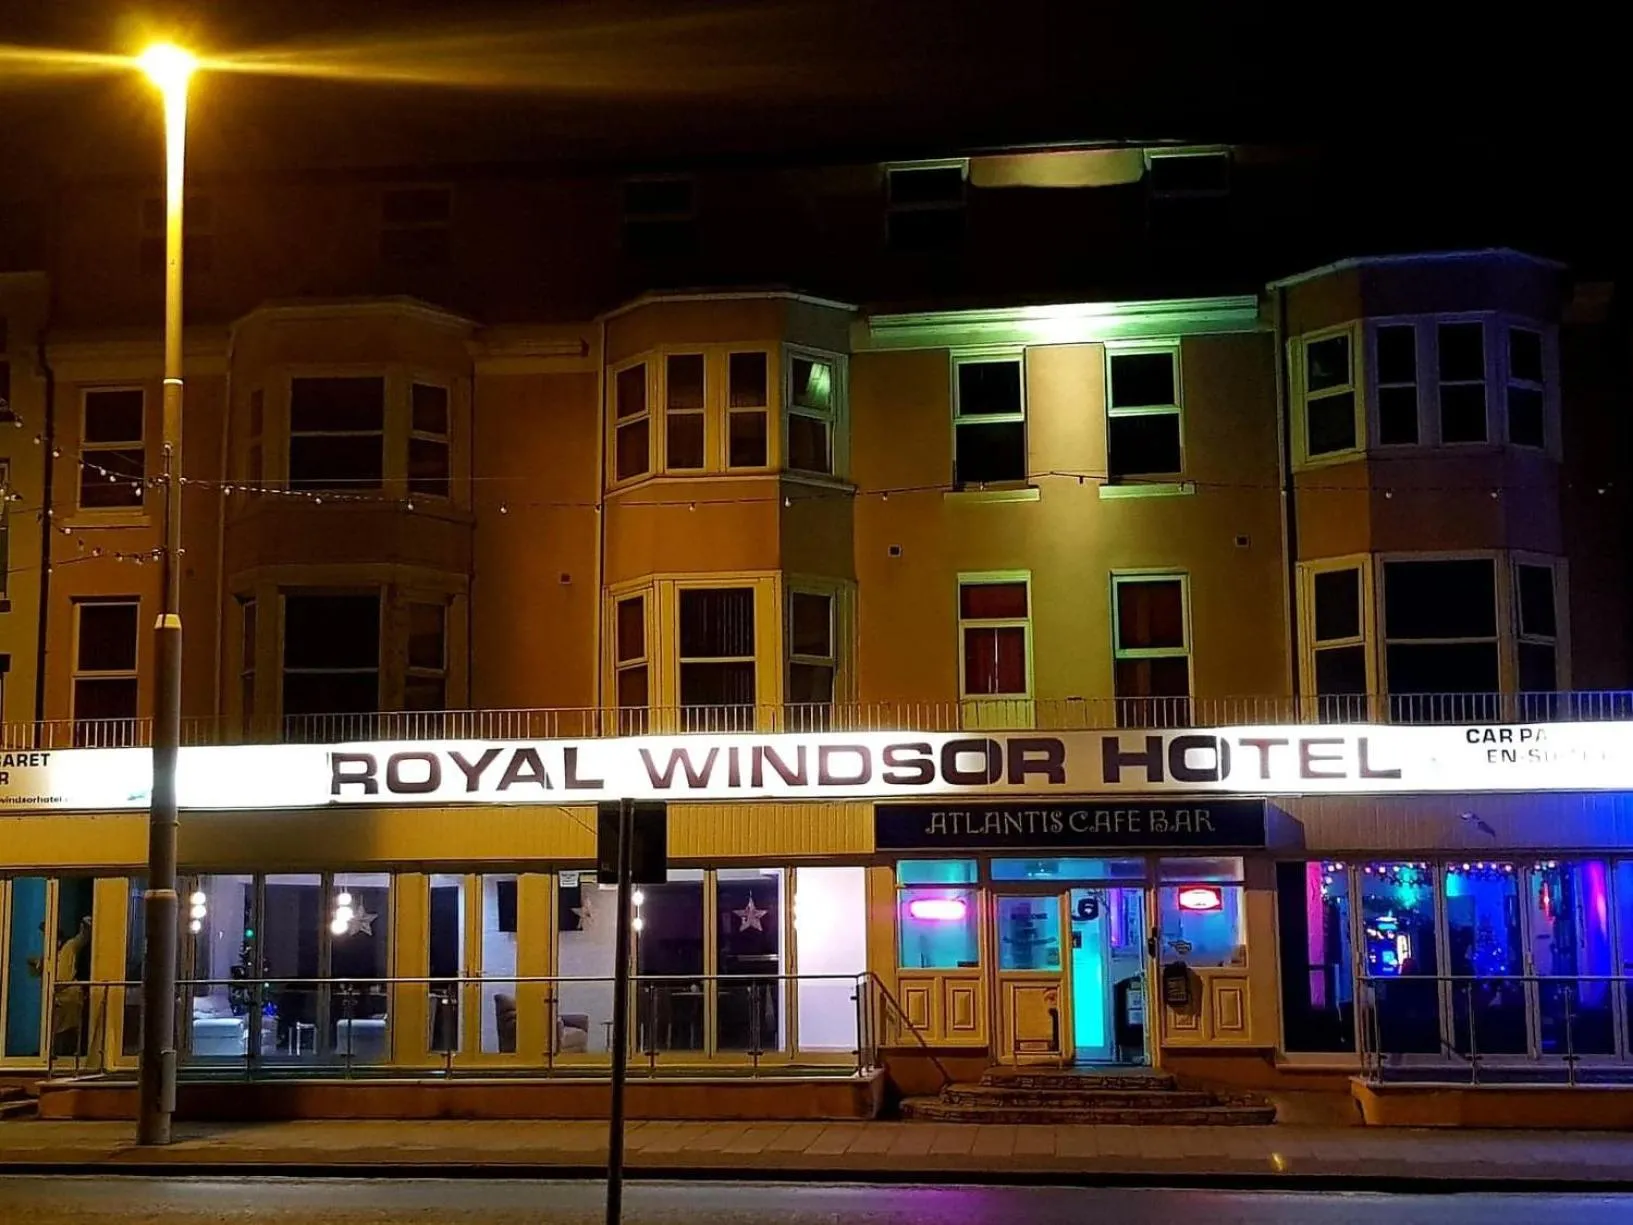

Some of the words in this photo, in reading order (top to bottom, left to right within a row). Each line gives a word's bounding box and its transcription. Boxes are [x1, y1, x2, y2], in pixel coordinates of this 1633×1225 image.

[1466, 727, 1513, 744] CAR
[0, 752, 51, 767] ARET
[331, 746, 605, 796] ROYAL
[638, 738, 1067, 789] WINDSOR
[1101, 734, 1402, 783] HOTEL
[925, 809, 1064, 836] ATLANTIS
[1068, 809, 1141, 834] CAFE
[1148, 808, 1217, 834] BAR
